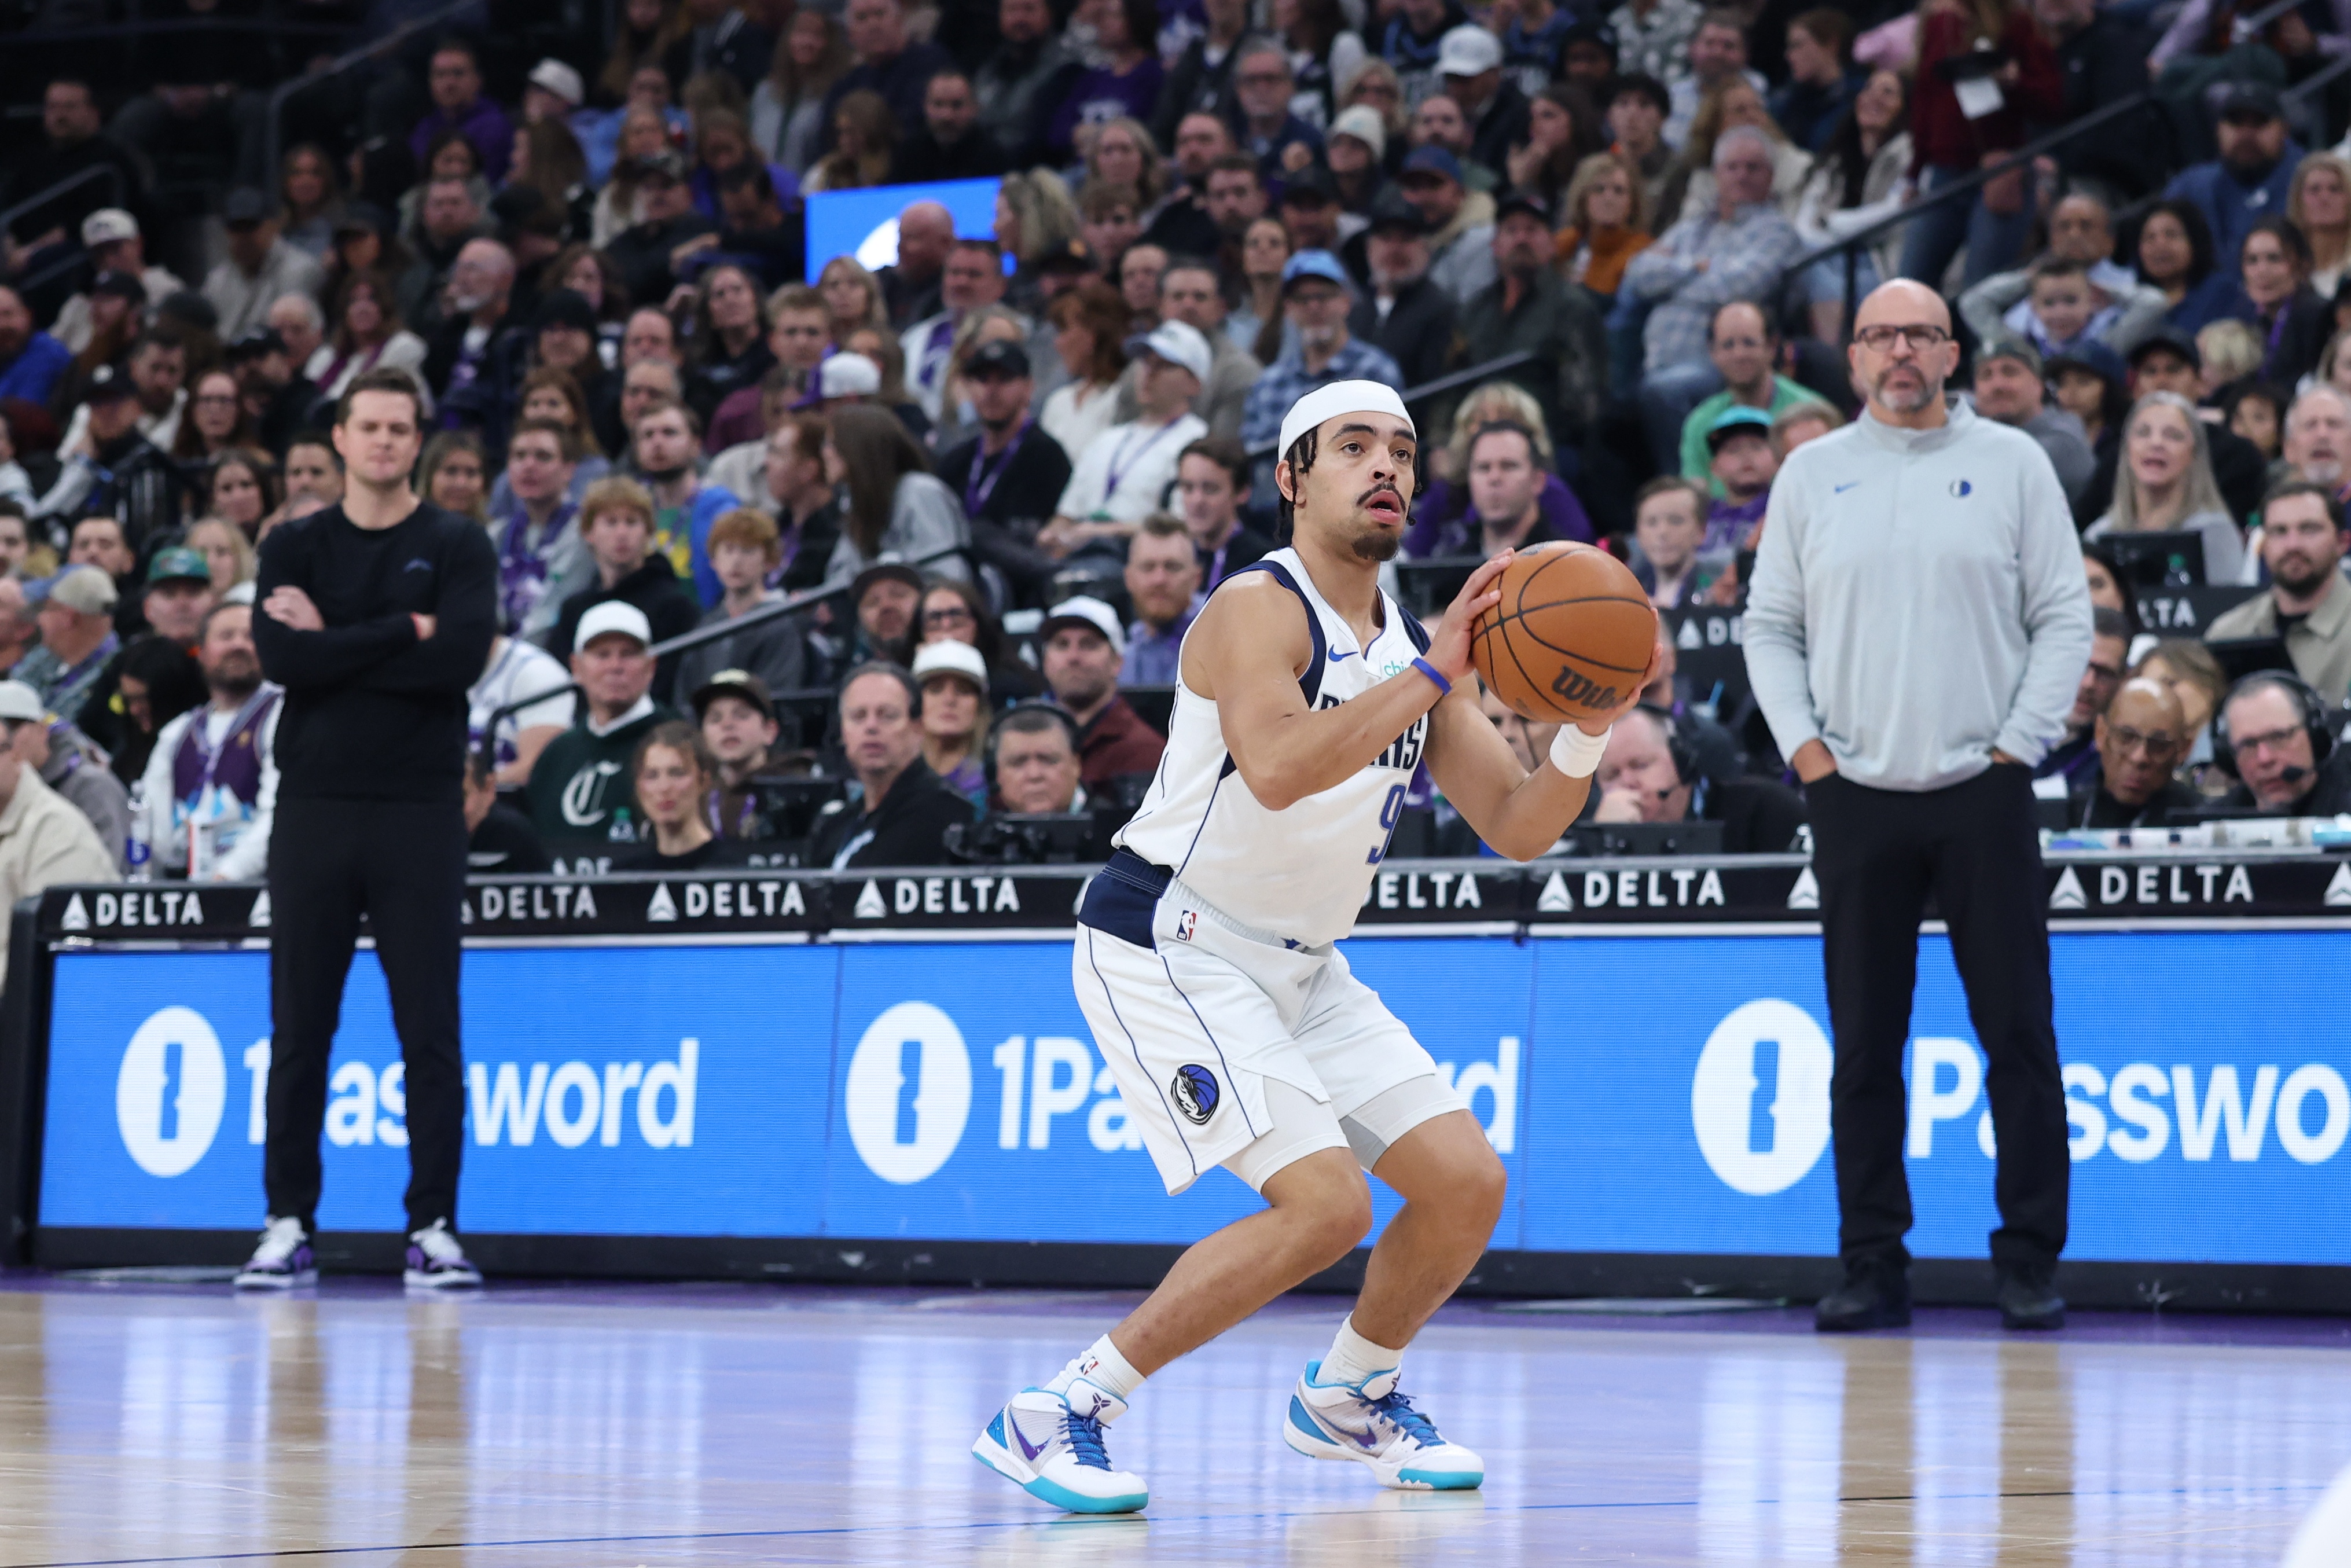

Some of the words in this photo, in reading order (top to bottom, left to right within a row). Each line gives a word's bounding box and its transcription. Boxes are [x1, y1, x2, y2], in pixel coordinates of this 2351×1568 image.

[2137, 596, 2197, 629] LTA
[1384, 660, 1406, 677] chi
[561, 760, 622, 827] C
[1365, 783, 1408, 865] 9
[481, 885, 598, 920] DELTA
[685, 881, 806, 917] DELTA
[894, 876, 1020, 913] DELTA
[1583, 869, 1725, 907] DELTA
[2100, 865, 2255, 905] DELTA
[95, 891, 204, 926] DELTA
